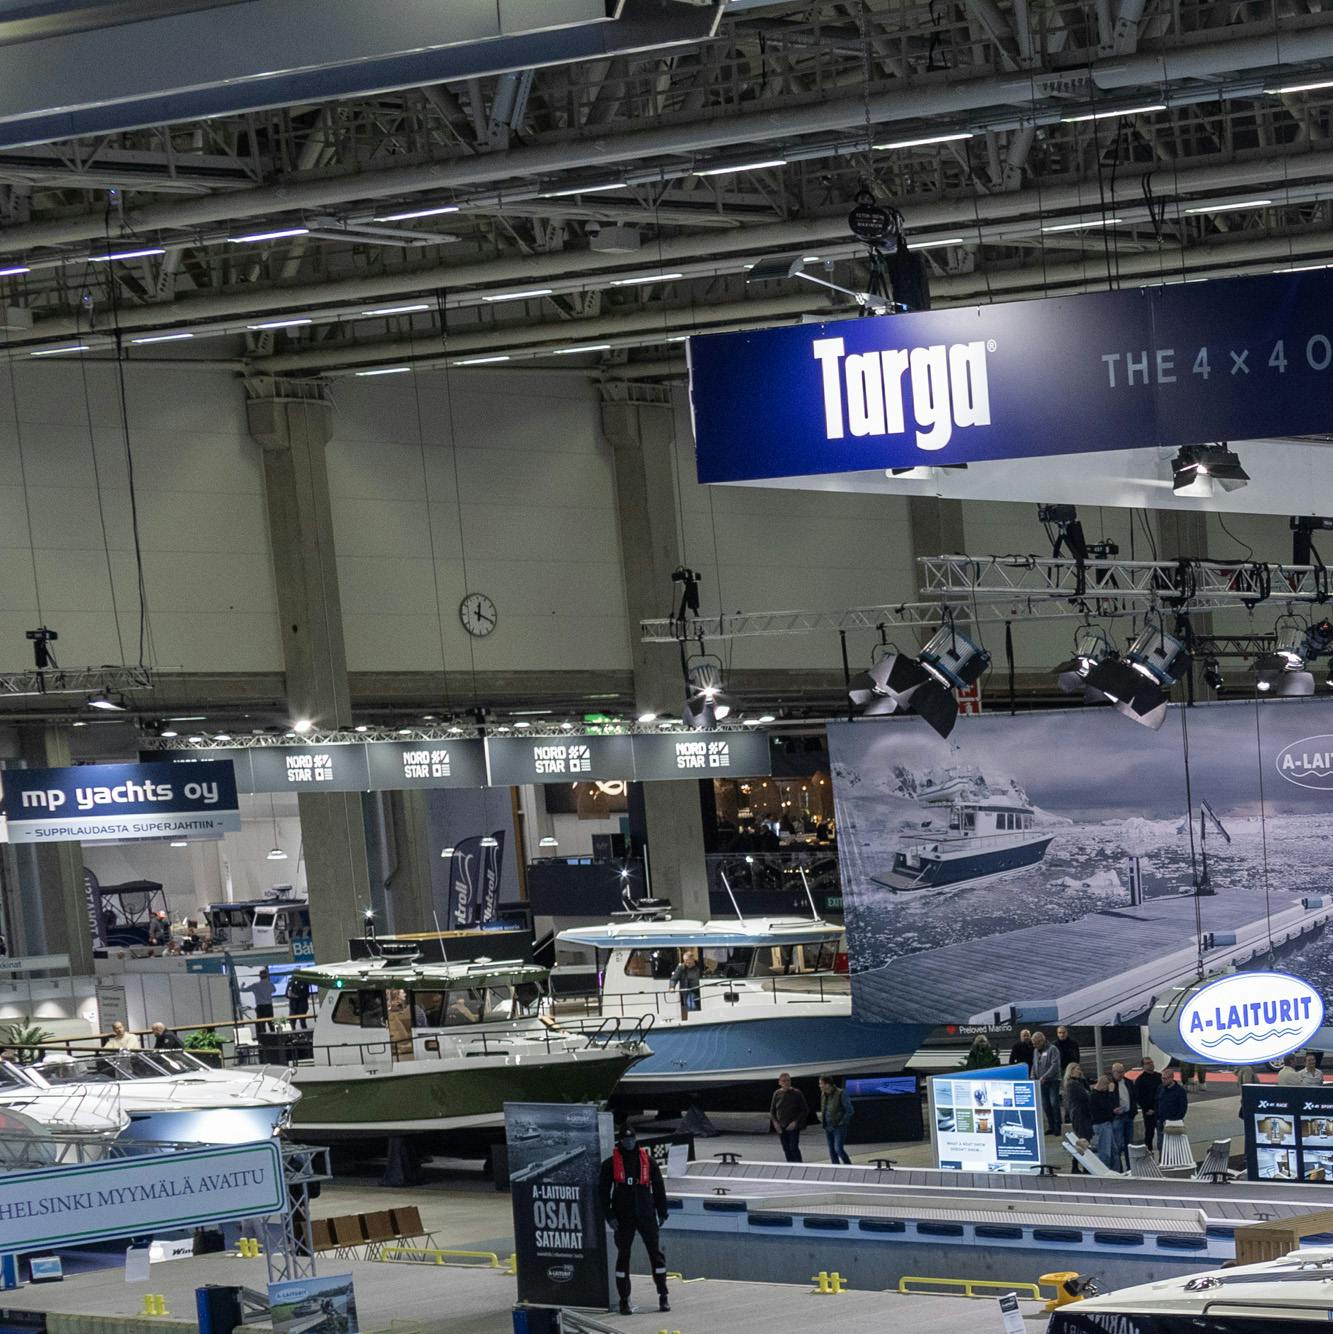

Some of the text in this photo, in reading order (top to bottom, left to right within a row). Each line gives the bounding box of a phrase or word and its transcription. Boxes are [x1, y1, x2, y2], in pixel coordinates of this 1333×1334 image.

[1102, 349, 1177, 387] THE
[1192, 347, 1211, 379] 4
[1268, 340, 1287, 373] 4
[813, 337, 991, 450] Targa
[534, 746, 567, 760] NORD
[676, 742, 707, 756] NORD
[286, 755, 313, 768] NORD
[403, 751, 430, 765] NORD
[535, 759, 566, 773] STAR
[677, 755, 707, 769] STAR
[287, 768, 313, 782] STAR
[404, 764, 430, 778] STAR
[21, 780, 219, 812] mp yachts oy
[34, 823, 129, 838] SUPPILAUDASTA
[133, 820, 214, 834] SUPERJAHTIIN
[1190, 997, 1312, 1033] A-LAITURIT
[0, 1167, 265, 1220] HELSINKI MYYMÄLÄ AVATTU
[532, 1185, 580, 1201] A-LAITURIT
[533, 1202, 582, 1230] OSAA
[536, 1231, 583, 1250] SATAMAT
